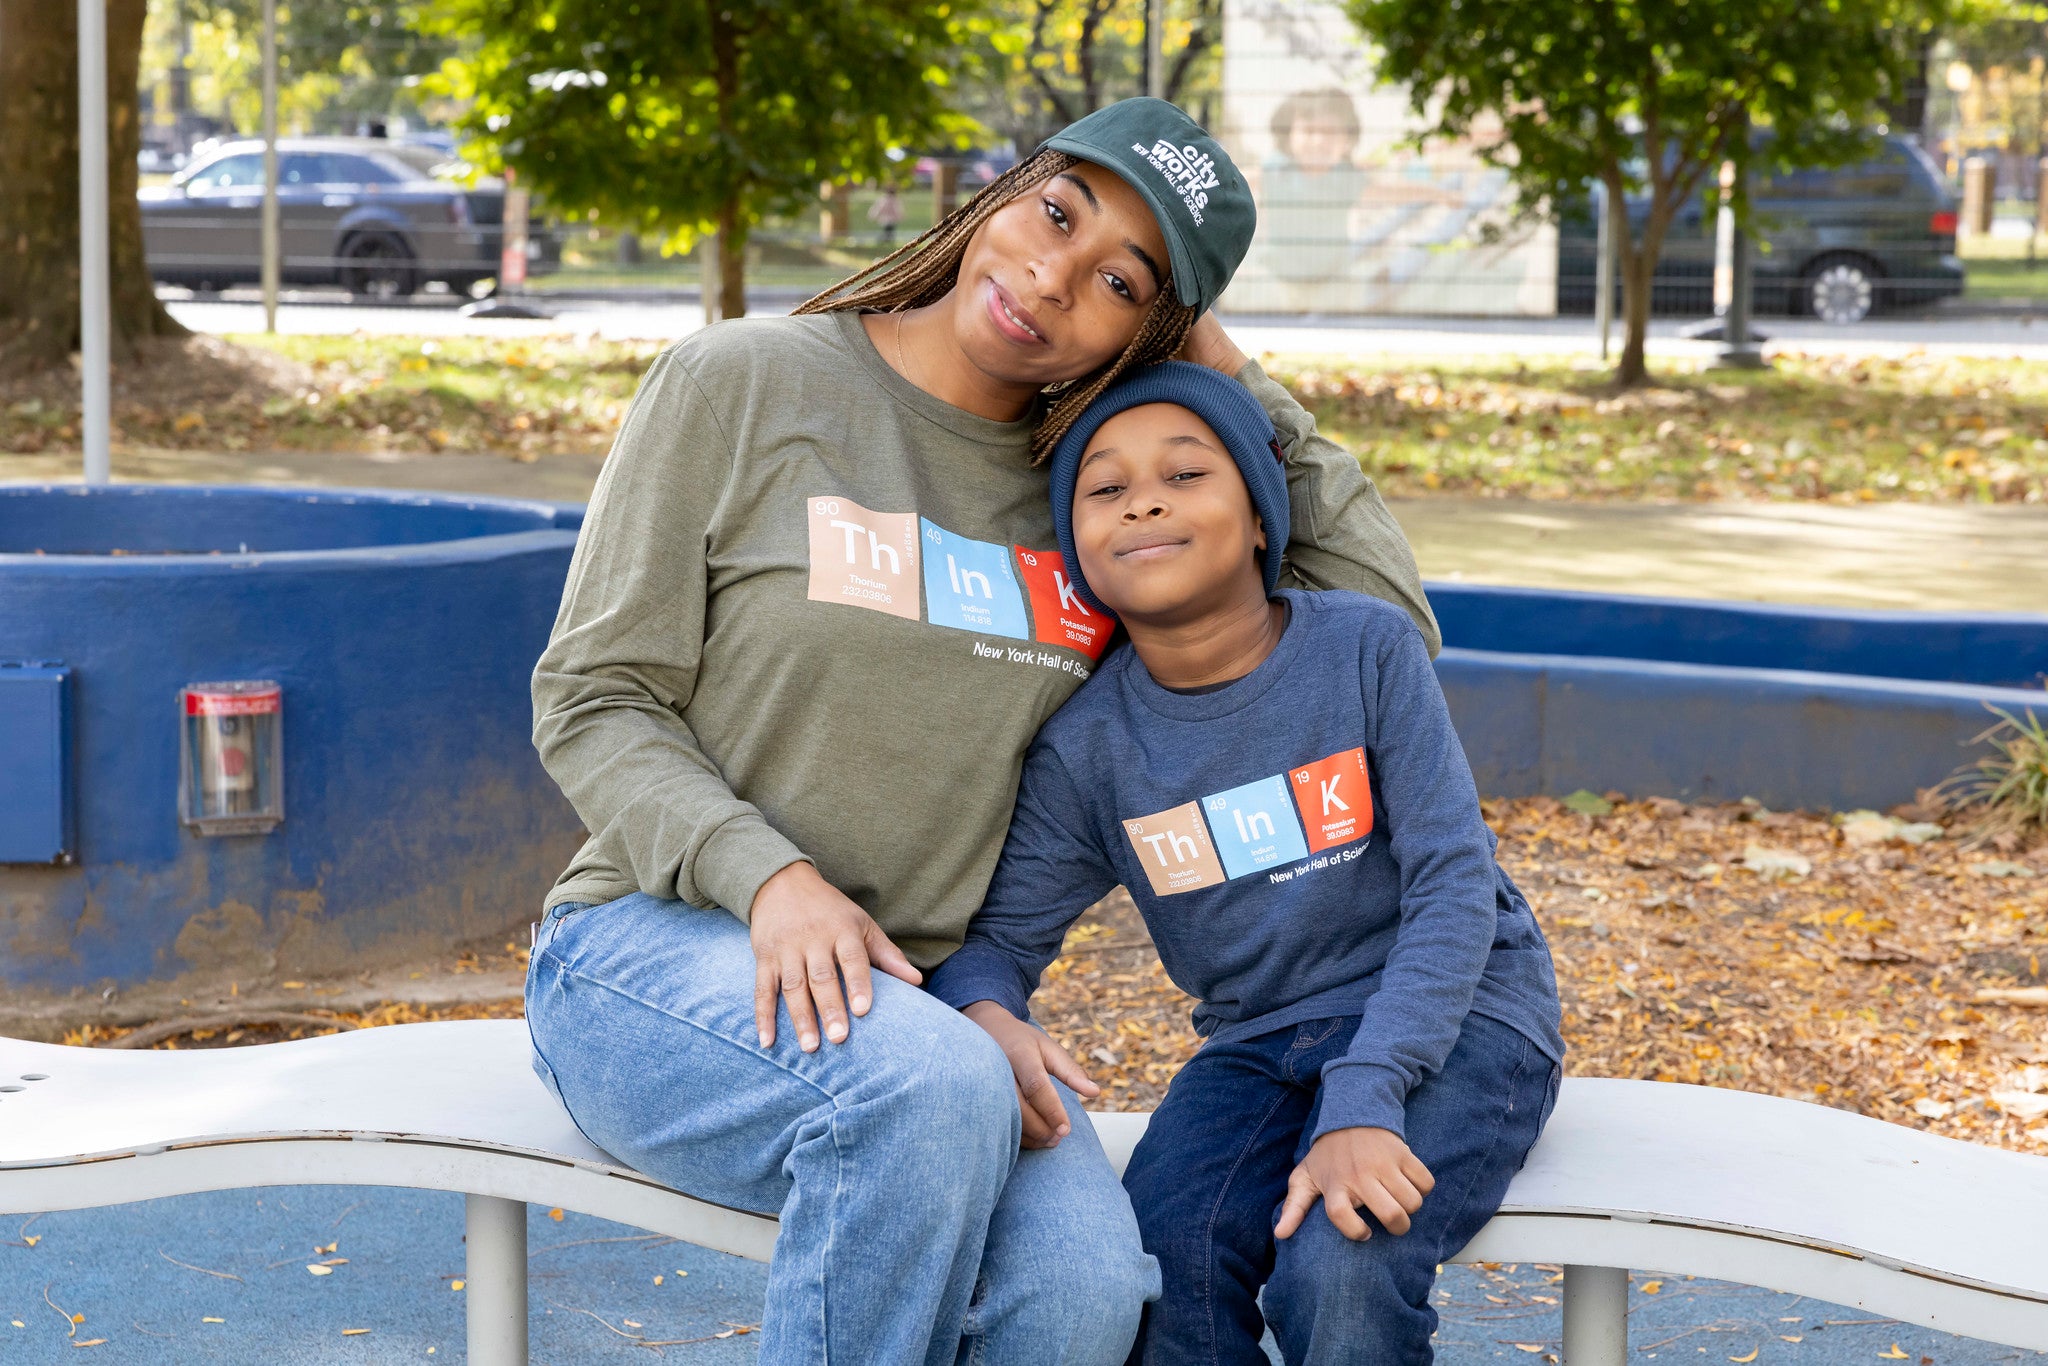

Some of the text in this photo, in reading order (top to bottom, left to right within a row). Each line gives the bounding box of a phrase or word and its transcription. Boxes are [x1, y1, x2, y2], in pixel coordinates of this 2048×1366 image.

[1151, 143, 1209, 209] works
[1182, 145, 1220, 189] city
[1131, 142, 1204, 227] NEW YORK HALL OF SCIENCE
[815, 501, 839, 516] 90
[926, 527, 943, 545] 49
[830, 519, 901, 575] Th
[1021, 552, 1038, 567] 19
[849, 574, 887, 591] Thorium
[946, 553, 993, 600] In
[1053, 570, 1091, 617] K
[960, 603, 990, 615] Indium
[1060, 617, 1096, 636] Potassium
[1066, 630, 1092, 646] 39.0983
[973, 641, 1004, 659] New
[1007, 647, 1035, 665] York
[1036, 651, 1061, 669] Hall
[1062, 659, 1074, 673] of
[1295, 770, 1310, 785] 19
[1209, 797, 1226, 812] 49
[1320, 774, 1351, 816] K
[1128, 823, 1144, 835] 90
[1232, 808, 1276, 844] In
[1322, 817, 1356, 833] Potassium
[1326, 826, 1355, 841] 39.0983
[1141, 830, 1200, 867] Th
[1269, 871, 1293, 884] New
[1294, 863, 1310, 878] York
[1310, 856, 1328, 871] Hall
[1330, 853, 1341, 865] of
